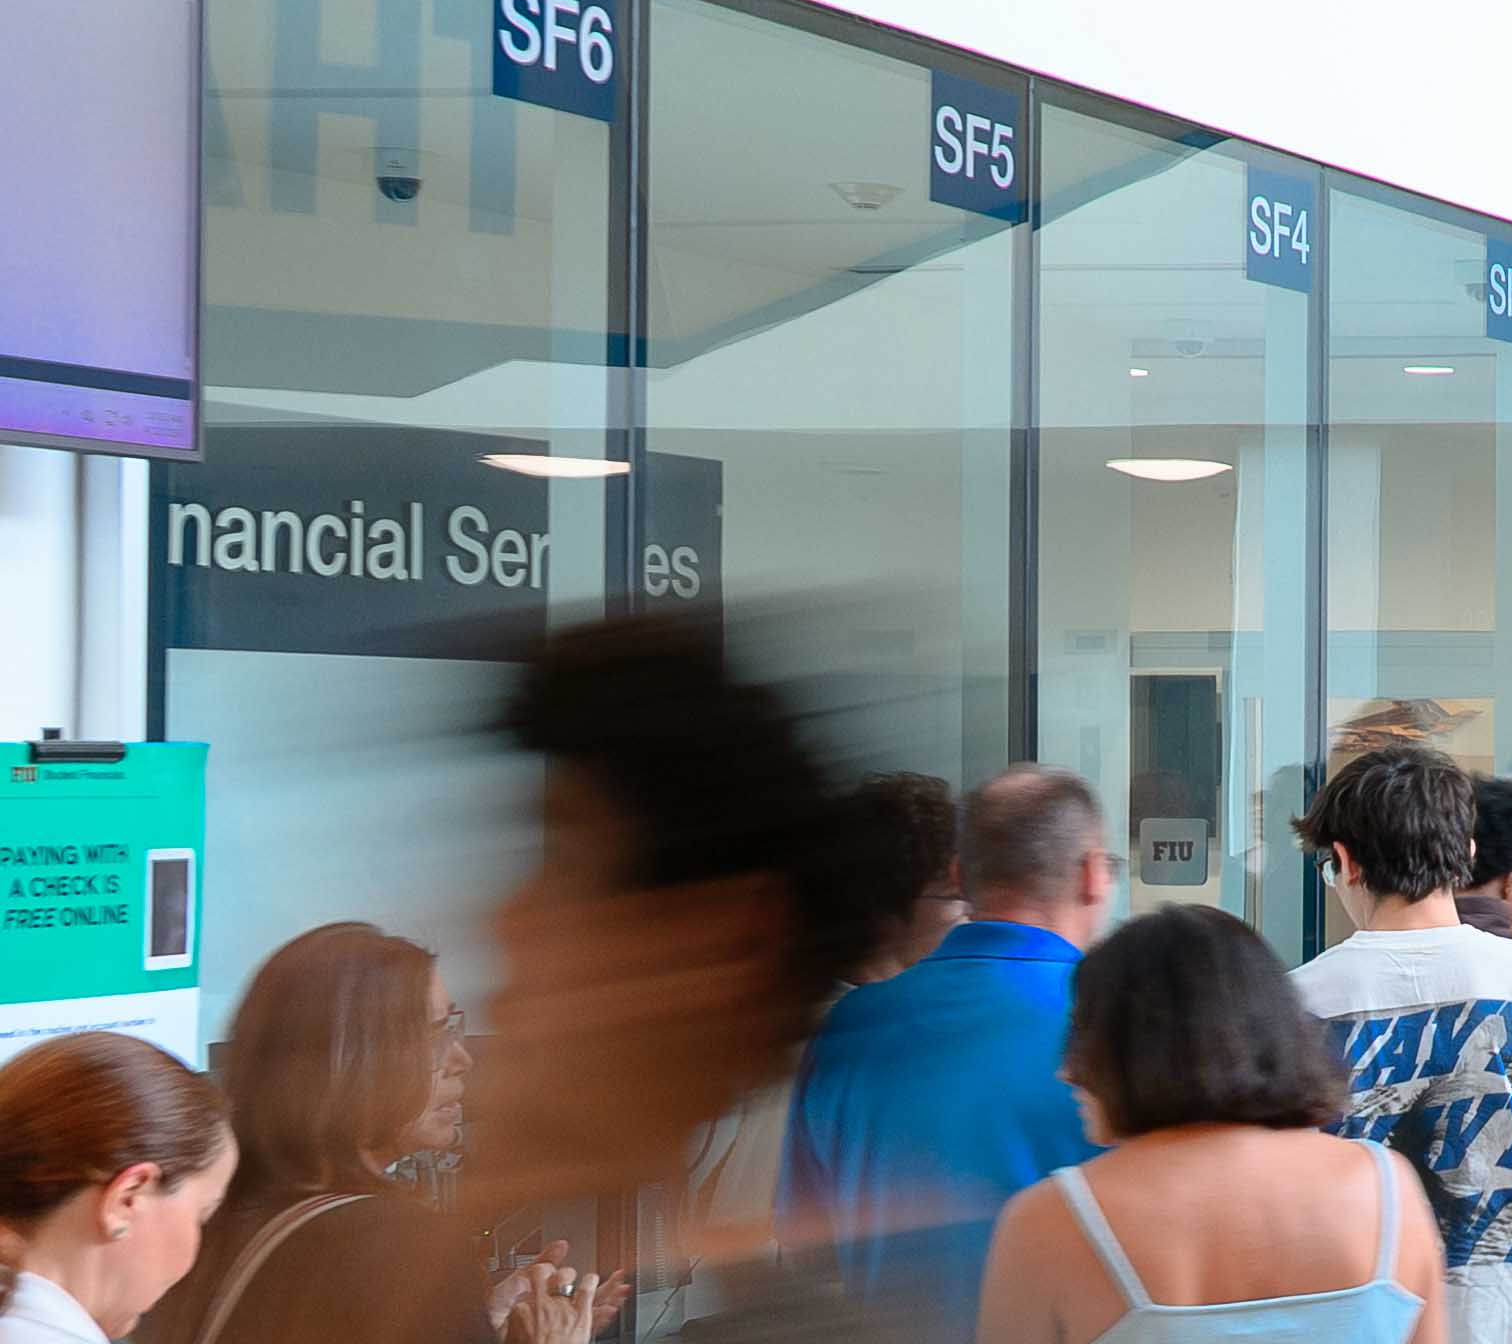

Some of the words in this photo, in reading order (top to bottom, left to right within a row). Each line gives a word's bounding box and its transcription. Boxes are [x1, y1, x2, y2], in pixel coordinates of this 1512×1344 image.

[933, 105, 1016, 190] SF5
[1249, 196, 1311, 265] SF4
[446, 505, 702, 599] Seres
[0, 844, 80, 867] PAYING
[1152, 840, 1194, 862] FIU
[9, 877, 26, 899] A
[29, 875, 102, 898] CHECK
[103, 874, 120, 895] IS
[3, 908, 57, 929] FREE
[59, 903, 130, 927] ONLINE
